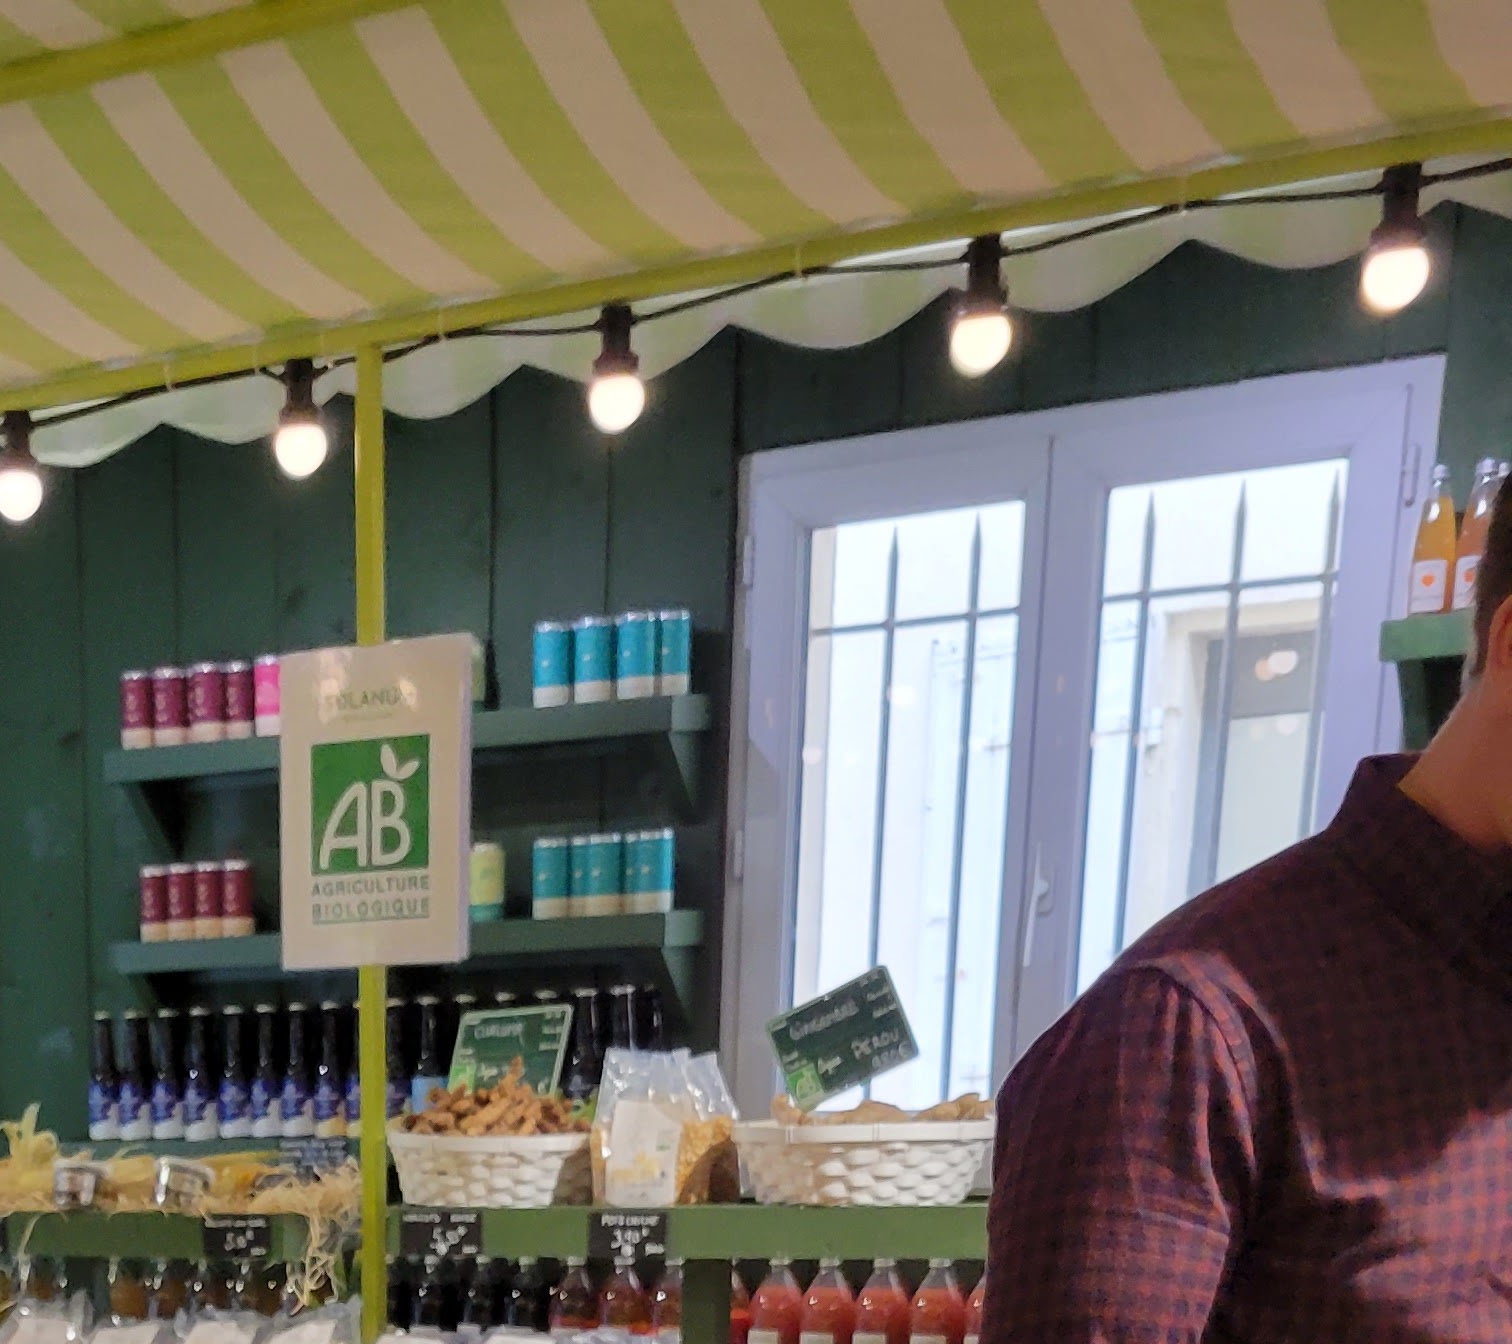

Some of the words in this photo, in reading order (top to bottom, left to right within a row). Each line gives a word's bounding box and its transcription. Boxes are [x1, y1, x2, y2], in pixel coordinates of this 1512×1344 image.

[319, 779, 411, 870] AB
[312, 874, 429, 897] AGRICULTURE
[312, 898, 430, 920] BIOLOGIQUE
